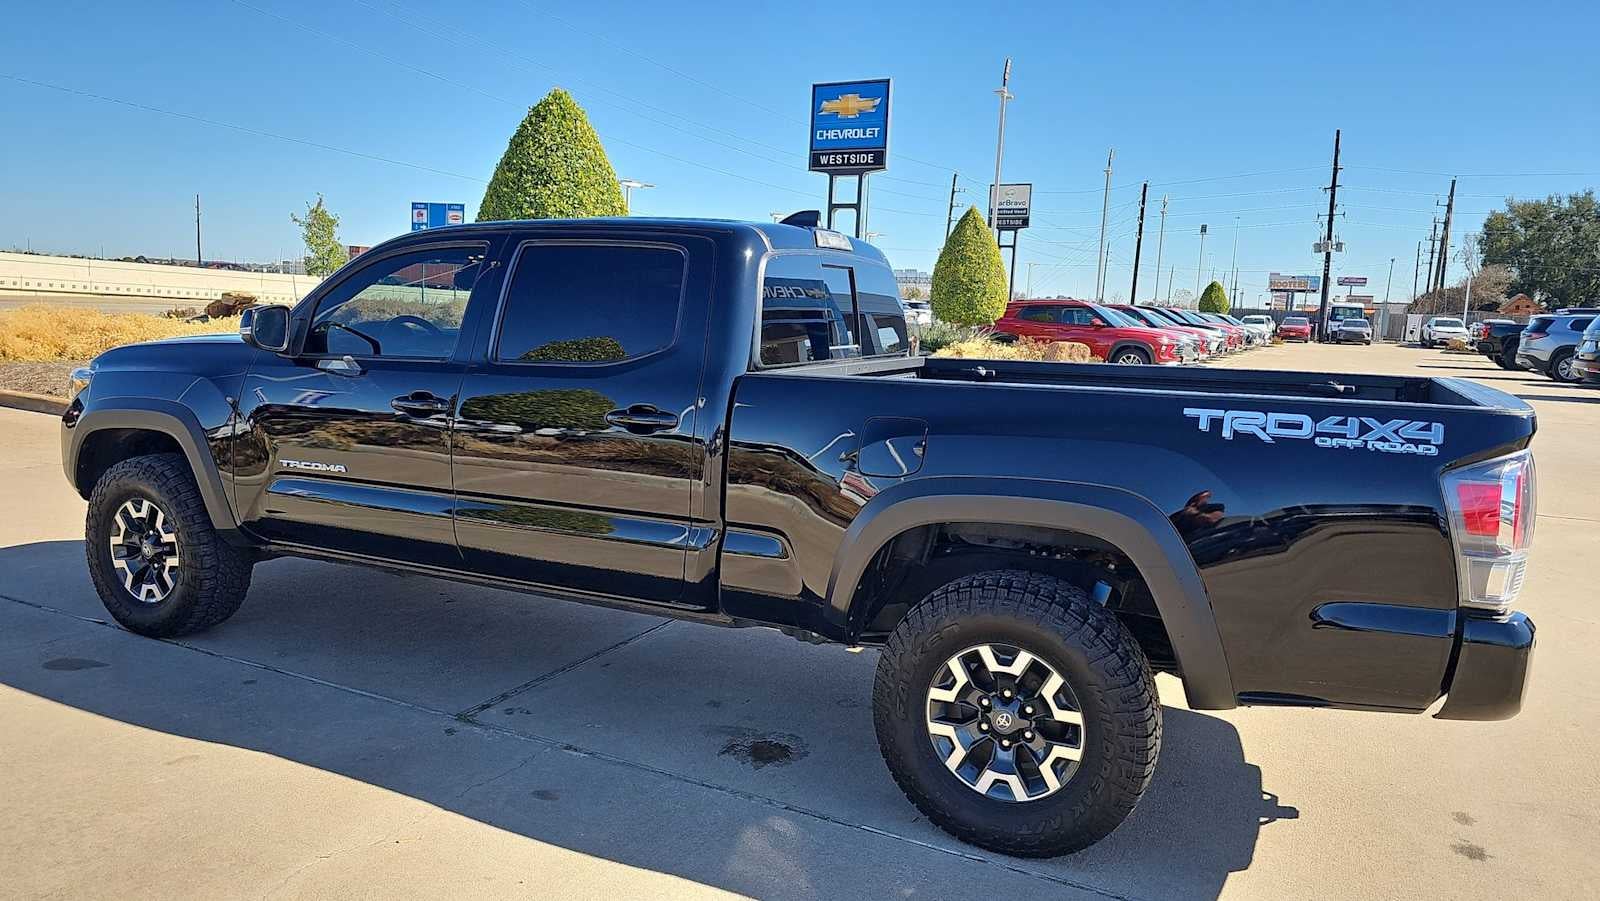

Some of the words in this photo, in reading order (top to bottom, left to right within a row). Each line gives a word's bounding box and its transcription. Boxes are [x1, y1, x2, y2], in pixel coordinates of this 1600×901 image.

[816, 127, 881, 140] CHEVROLET
[820, 153, 875, 165] WESTSIDE
[998, 199, 1027, 207] arBravo
[1270, 279, 1308, 289] HOOTERS
[1183, 408, 1315, 443] TRD
[1315, 436, 1366, 450] OFF
[1367, 440, 1439, 456] ROAD
[279, 459, 347, 473] TACOMA
